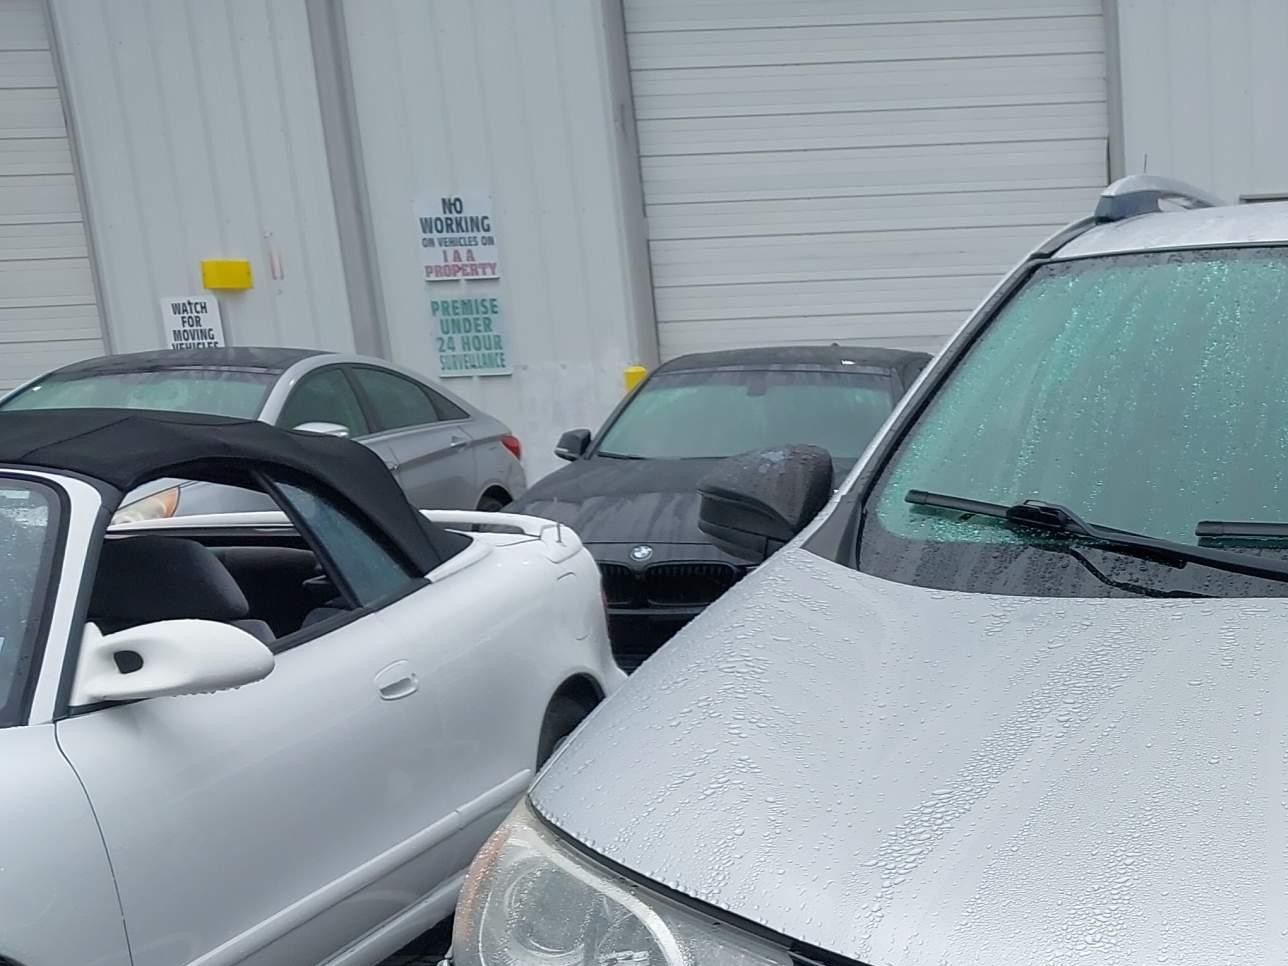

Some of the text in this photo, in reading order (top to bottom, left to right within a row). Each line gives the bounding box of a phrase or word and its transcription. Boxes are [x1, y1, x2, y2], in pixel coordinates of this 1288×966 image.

[441, 197, 464, 215] NO
[419, 215, 491, 234] WORKING
[422, 235, 495, 248] ON VEHICLES ON
[424, 262, 497, 278] PROPERTY
[171, 300, 208, 315] WATCH
[431, 298, 499, 317] PREMISE
[181, 315, 202, 328] FOR
[440, 316, 493, 335] UNDER
[172, 328, 215, 341] MOVING
[436, 334, 504, 353] 24 HOUR
